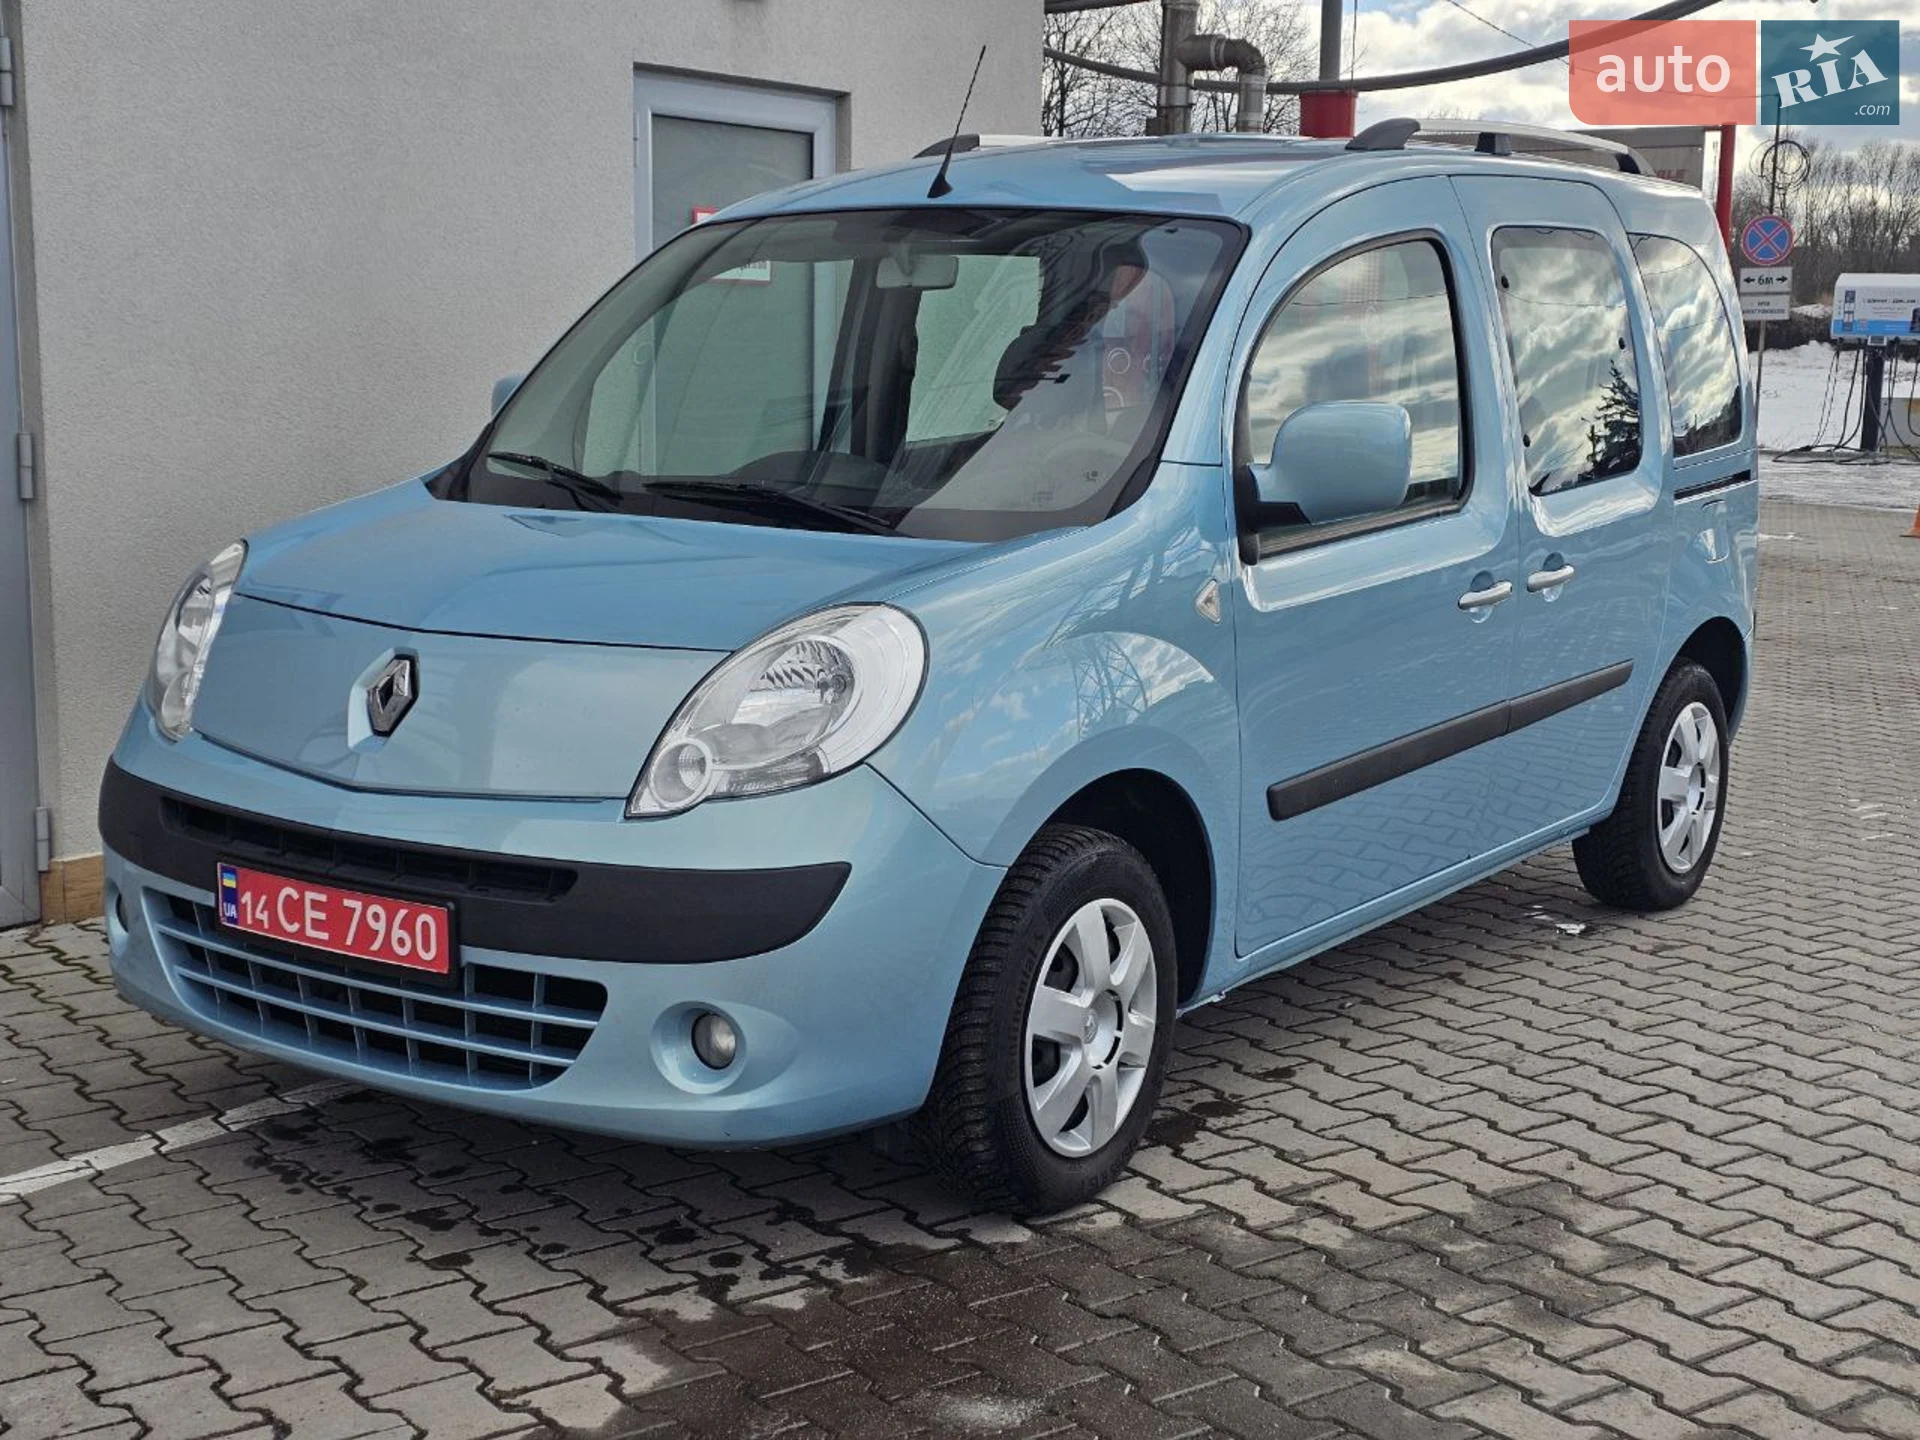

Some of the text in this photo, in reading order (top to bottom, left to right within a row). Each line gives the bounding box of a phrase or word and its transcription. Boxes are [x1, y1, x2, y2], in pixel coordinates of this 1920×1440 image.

[223, 901, 238, 919] UA
[241, 886, 438, 962] 14 CE 7960
